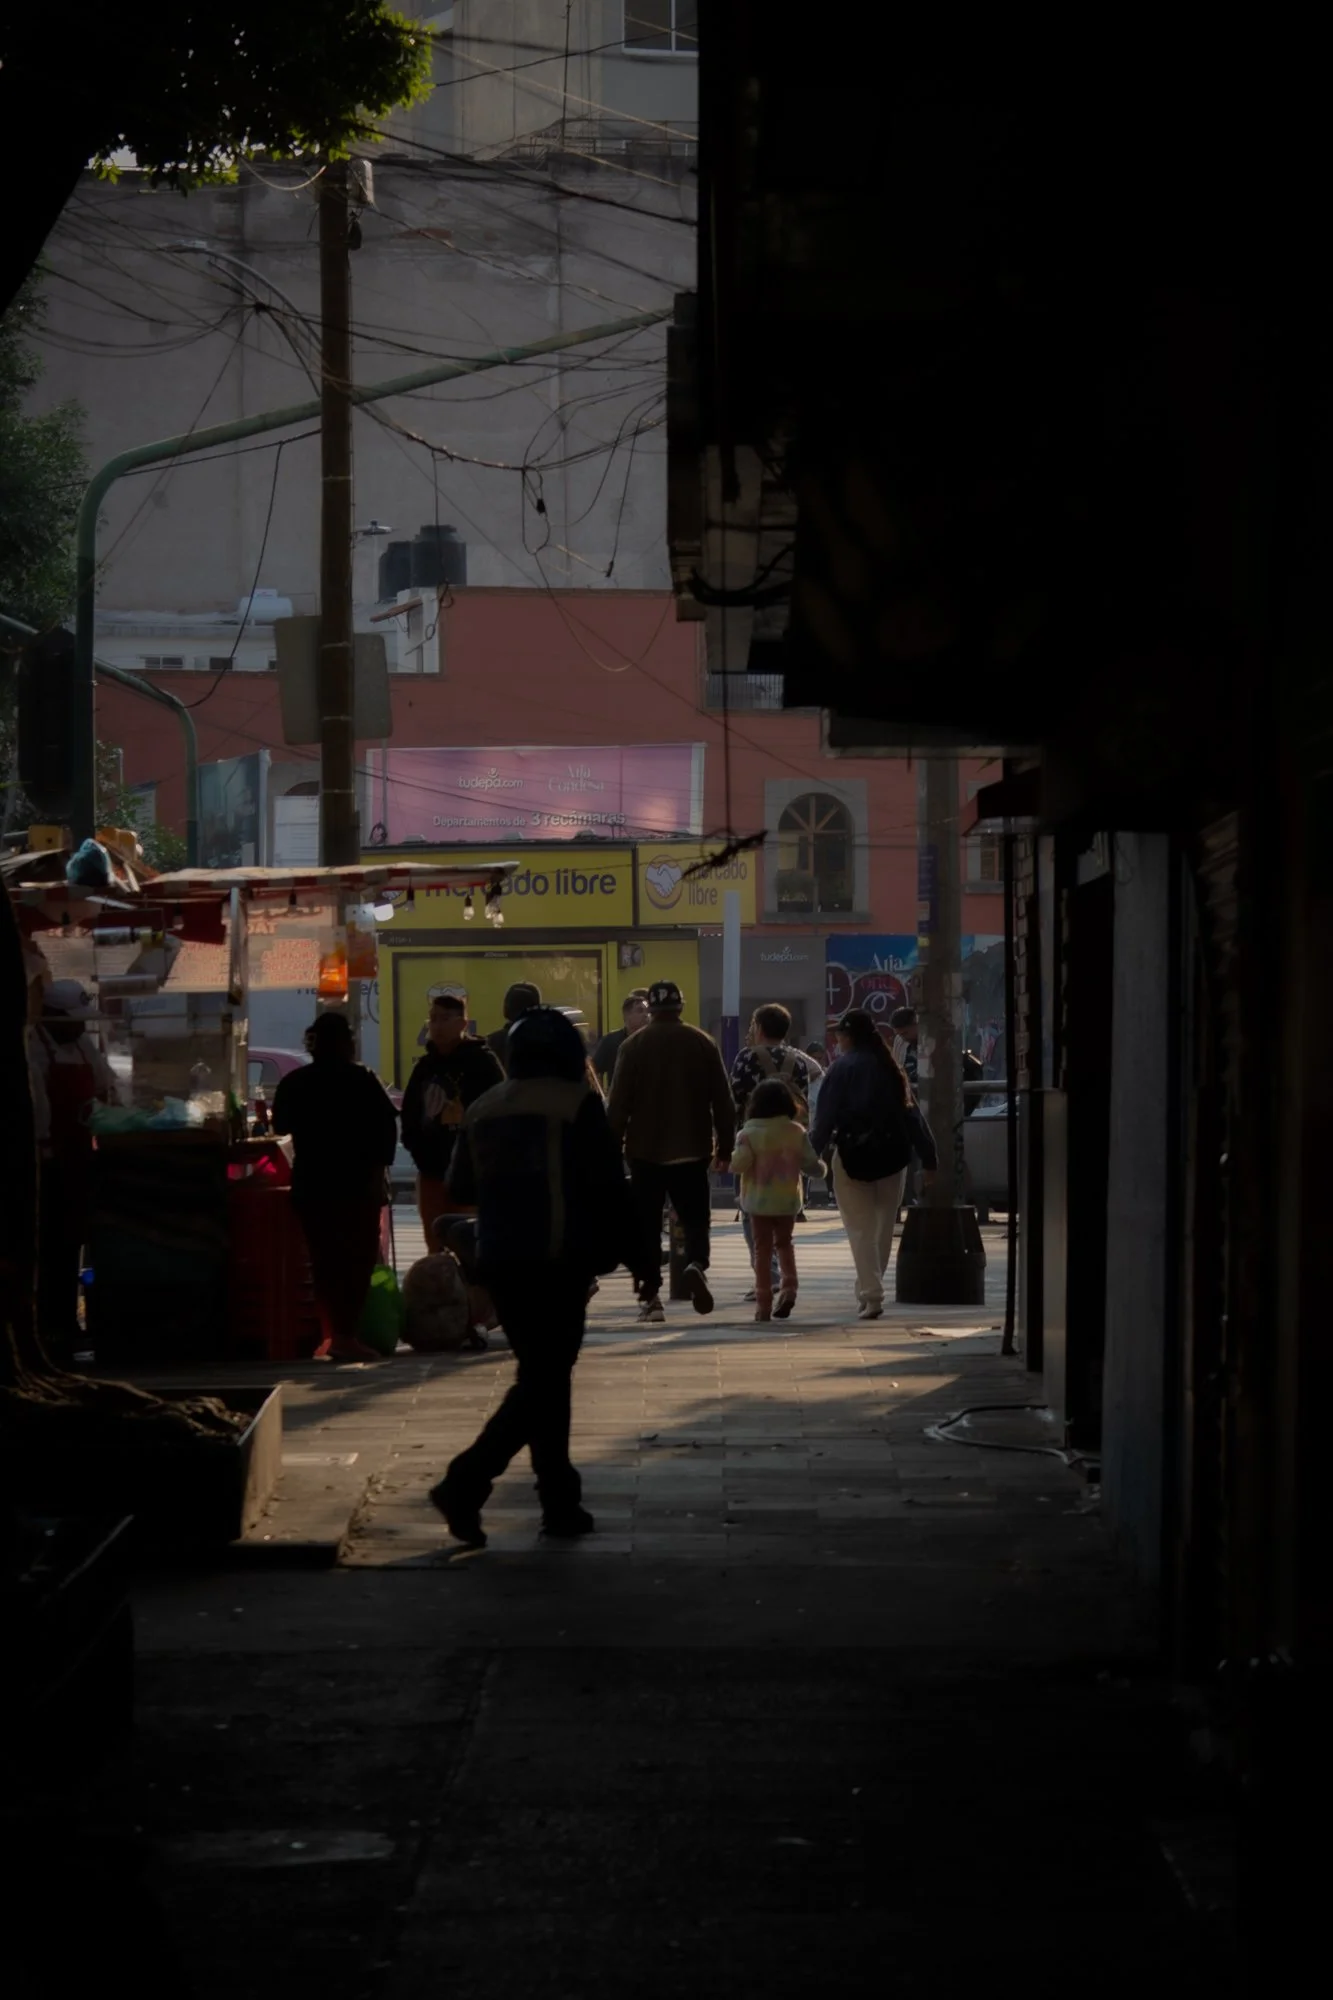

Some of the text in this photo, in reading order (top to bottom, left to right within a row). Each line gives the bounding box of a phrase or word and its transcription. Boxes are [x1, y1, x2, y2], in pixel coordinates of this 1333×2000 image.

[458, 775, 524, 791] tudepa.com
[432, 810, 626, 828] Departamentos de 3 recámaras
[556, 868, 617, 896] libre
[688, 882, 718, 906] libre
